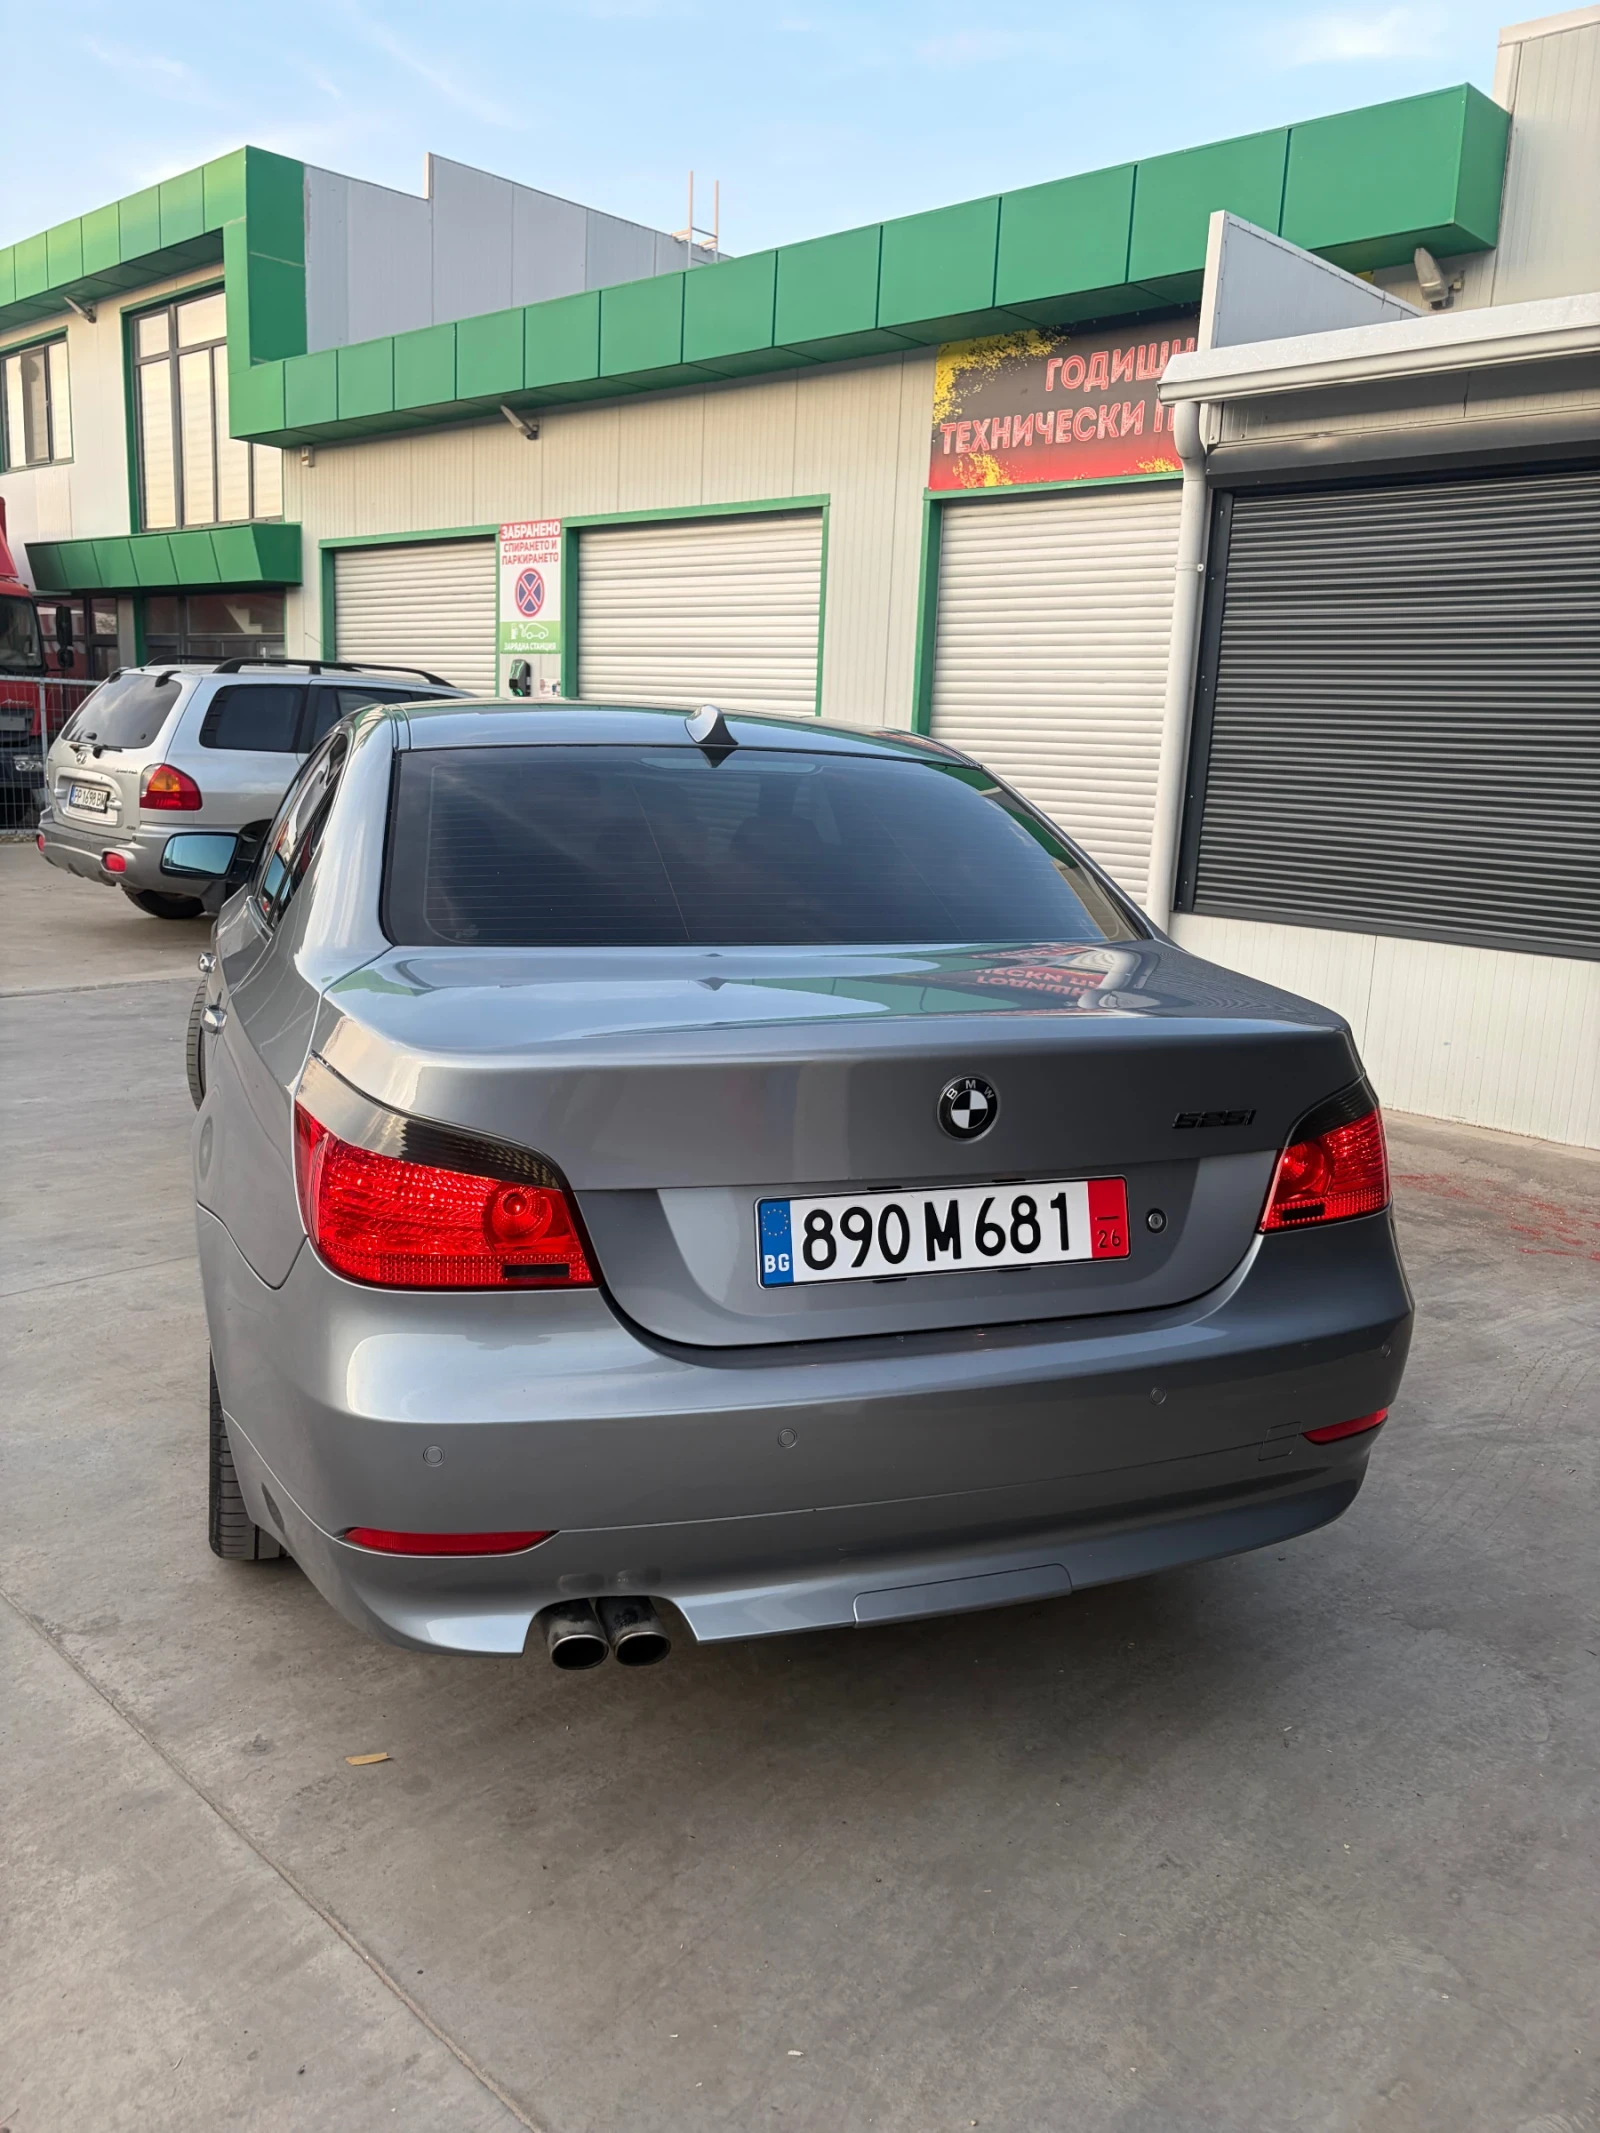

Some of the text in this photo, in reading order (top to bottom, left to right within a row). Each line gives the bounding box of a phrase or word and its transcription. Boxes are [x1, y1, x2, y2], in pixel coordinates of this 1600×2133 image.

[940, 400, 1145, 454] ТЕХНИЧЕСКИ
[501, 523, 561, 540] ЗАБРАНЕНО
[503, 540, 557, 553] СПИРАНЕТО И
[502, 552, 559, 565] ПАРКИРАНЕТО
[946, 1079, 995, 1100] BMW
[802, 1192, 1069, 1271] 890 M 681
[1097, 1229, 1121, 1248] 26
[764, 1253, 790, 1273] BG
